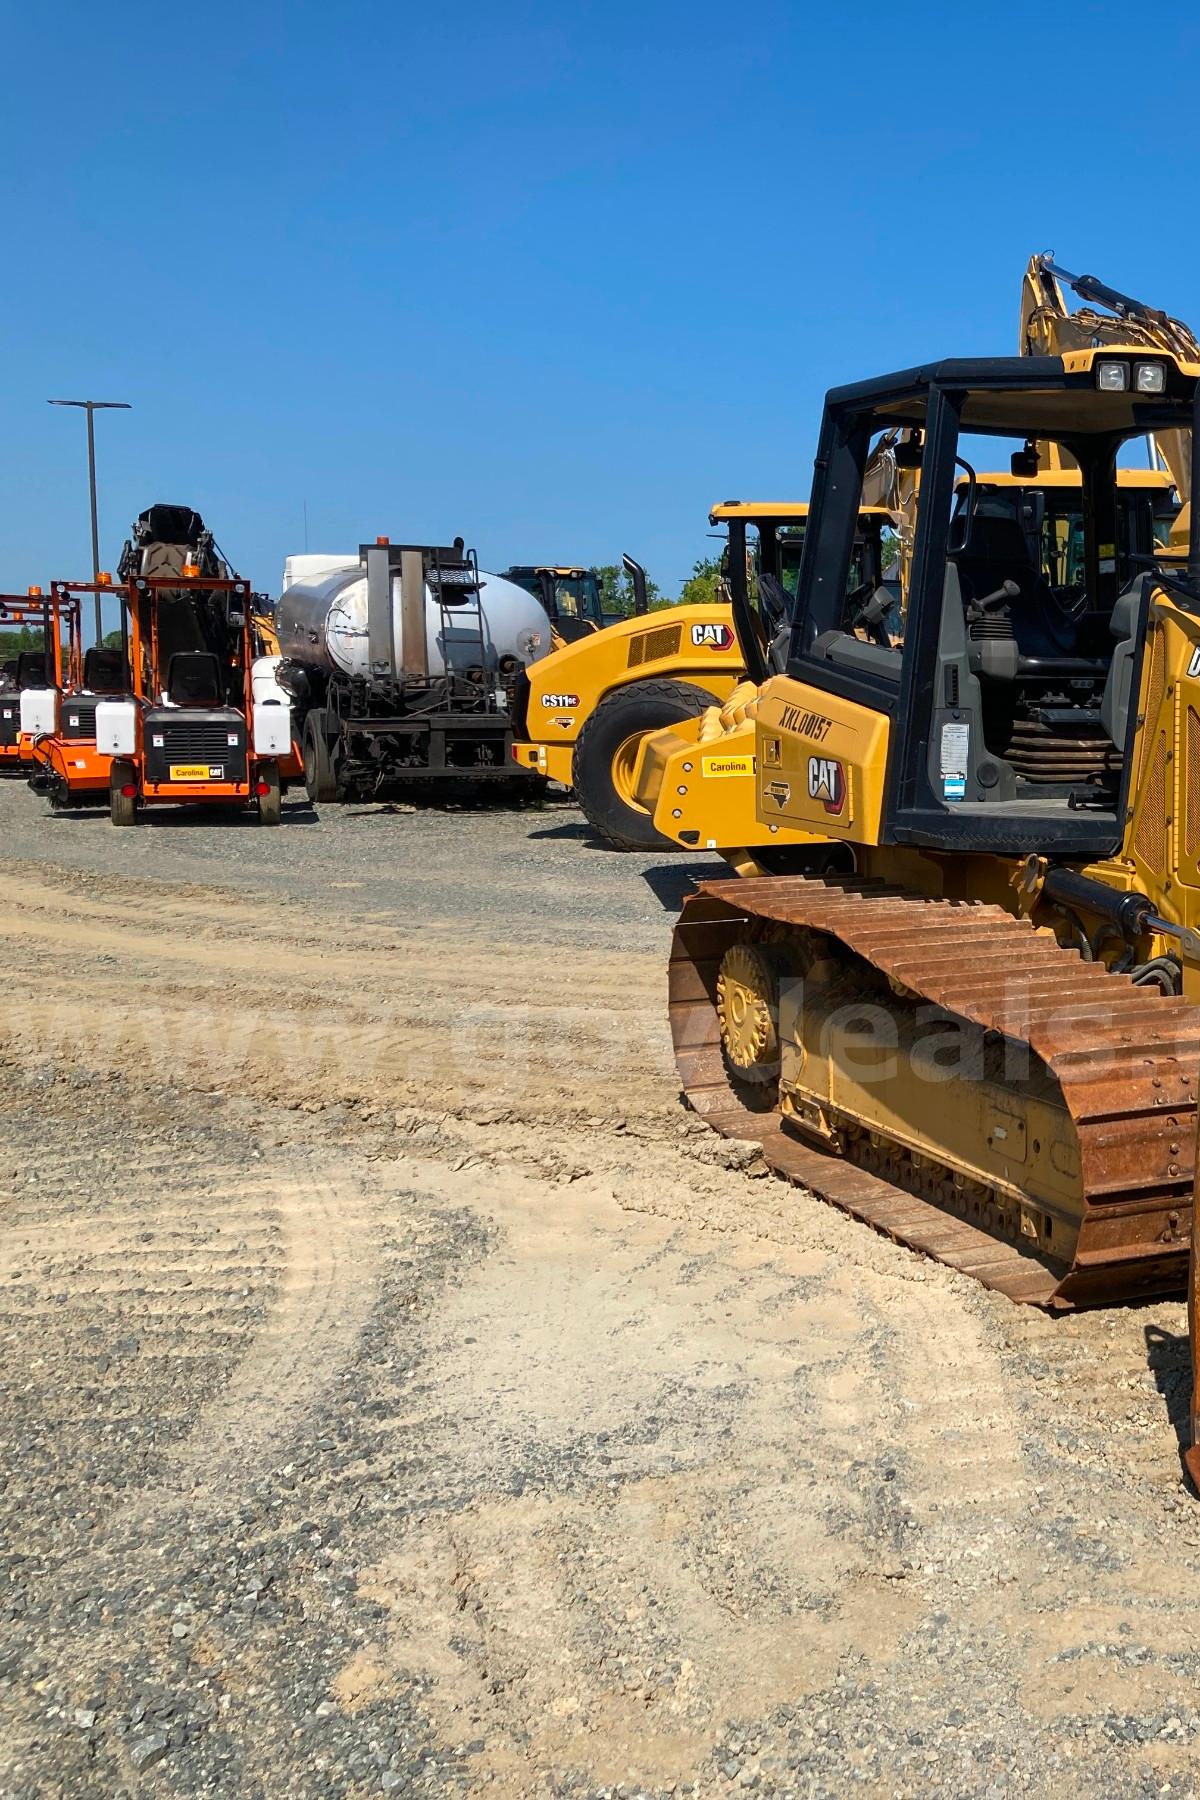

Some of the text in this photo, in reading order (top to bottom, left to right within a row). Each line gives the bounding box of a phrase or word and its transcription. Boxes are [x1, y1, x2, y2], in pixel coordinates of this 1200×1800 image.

[691, 625, 724, 645] CAT
[778, 705, 833, 743] XKL00157
[175, 768, 222, 777] Carolina CAT
[710, 762, 747, 772] Carolina
[808, 757, 839, 802] CAT
